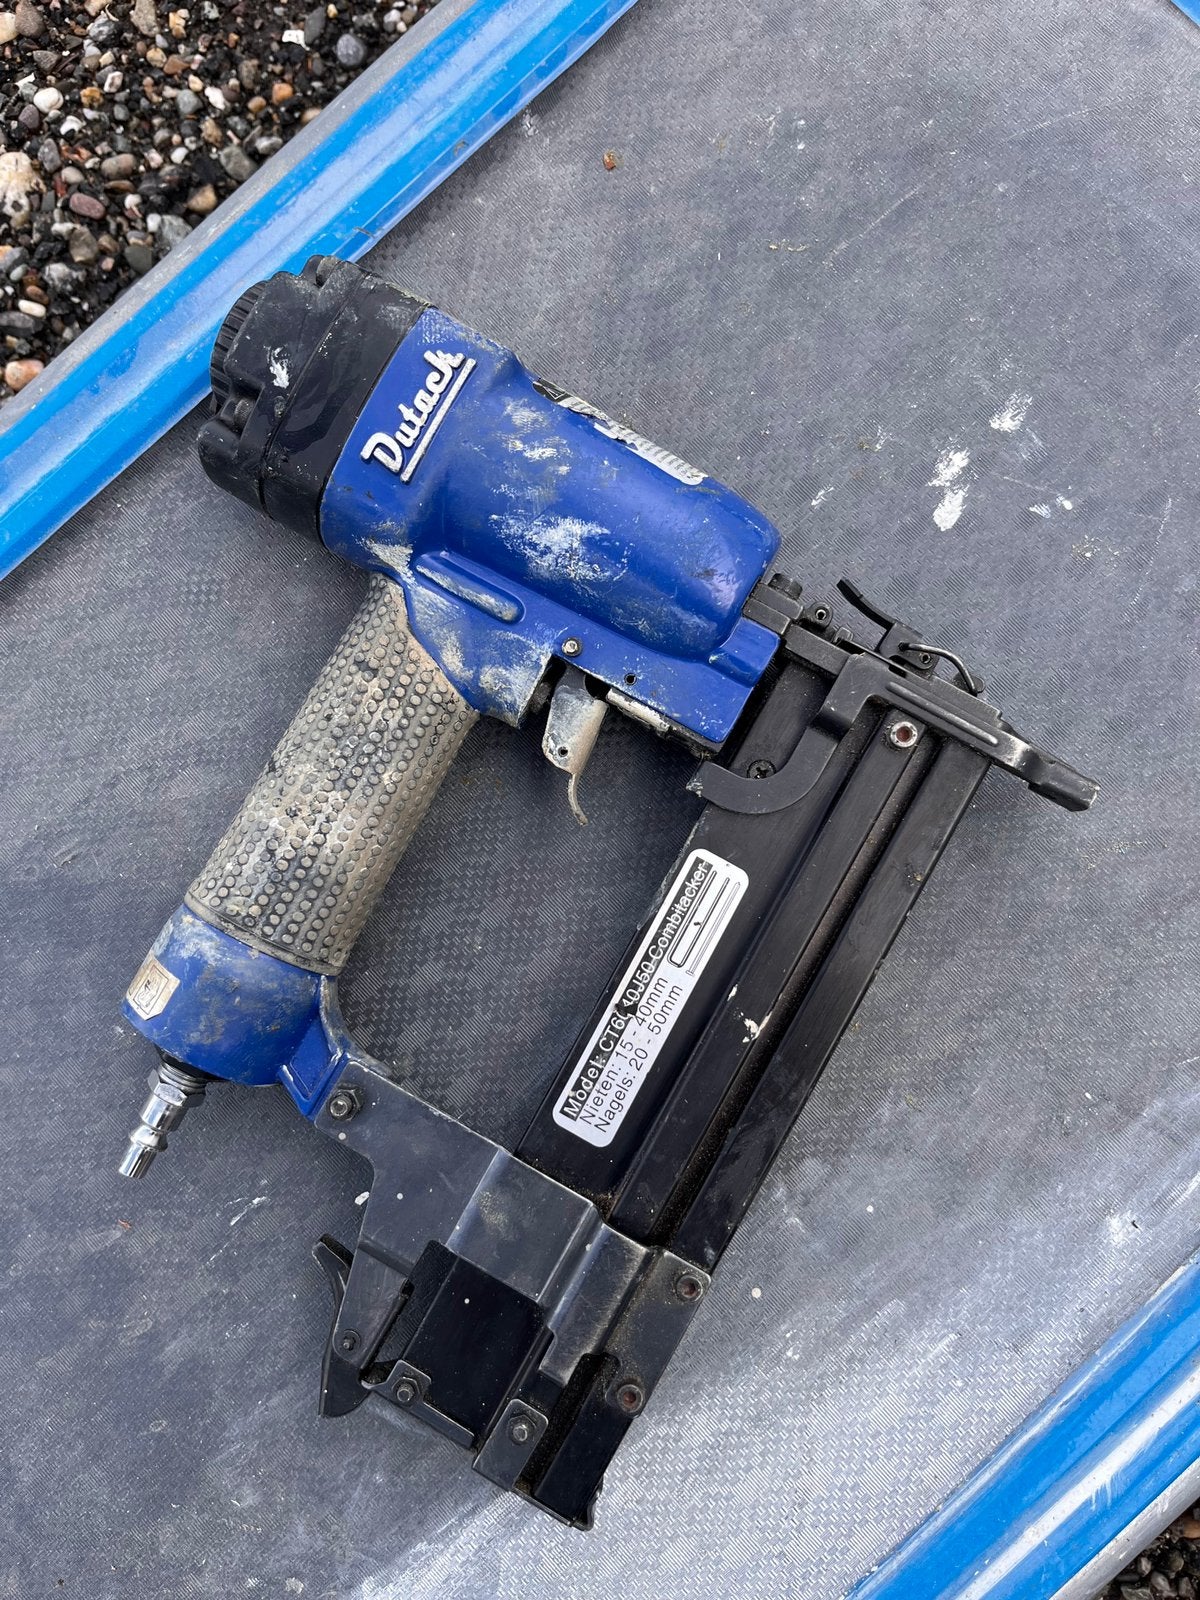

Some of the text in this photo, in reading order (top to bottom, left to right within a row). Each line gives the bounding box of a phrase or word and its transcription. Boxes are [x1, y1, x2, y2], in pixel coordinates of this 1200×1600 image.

[360, 350, 466, 473] Dutack
[563, 1056, 606, 1118] Model:
[649, 861, 708, 960] Combitacker
[579, 1063, 622, 1125] Nieten:
[615, 1039, 634, 1060] 15
[635, 977, 669, 1026] 40mm
[594, 1072, 636, 1133] Nagels:
[628, 1047, 648, 1071] 20
[647, 985, 683, 1035] 50mm
